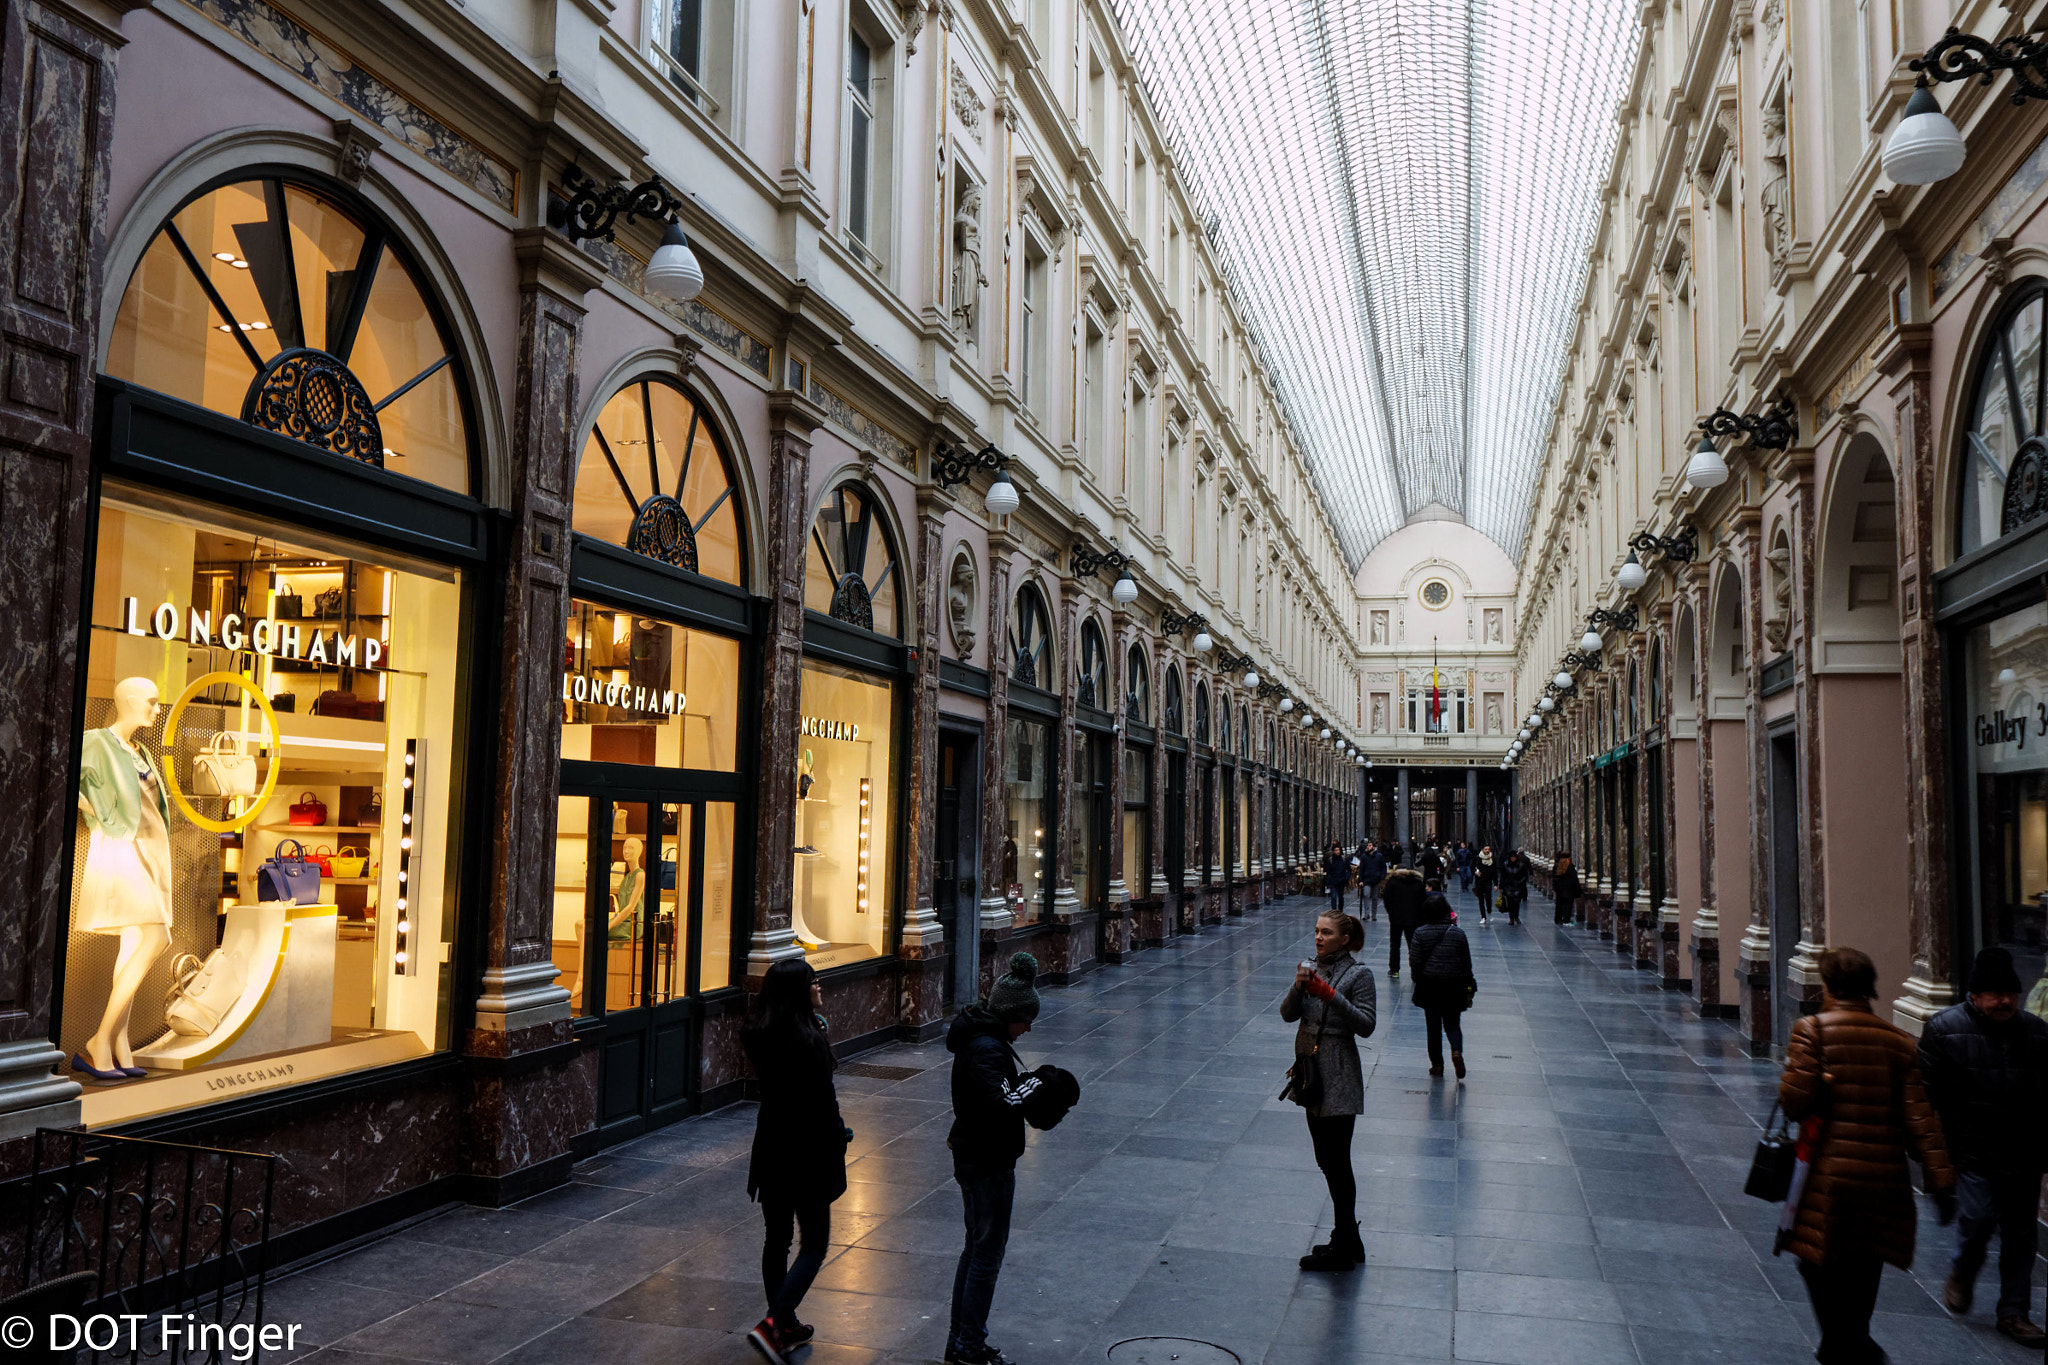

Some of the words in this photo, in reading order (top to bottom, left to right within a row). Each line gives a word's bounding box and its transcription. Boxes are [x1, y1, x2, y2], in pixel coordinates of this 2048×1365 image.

[124, 596, 382, 670] LONGCHAMP
[562, 672, 687, 715] LONGCHAMP
[801, 715, 860, 742] NGCHAMP
[1975, 709, 2028, 750] Gallery
[2037, 702, 2048, 737] 3
[206, 1063, 295, 1091] LONGCHAMP
